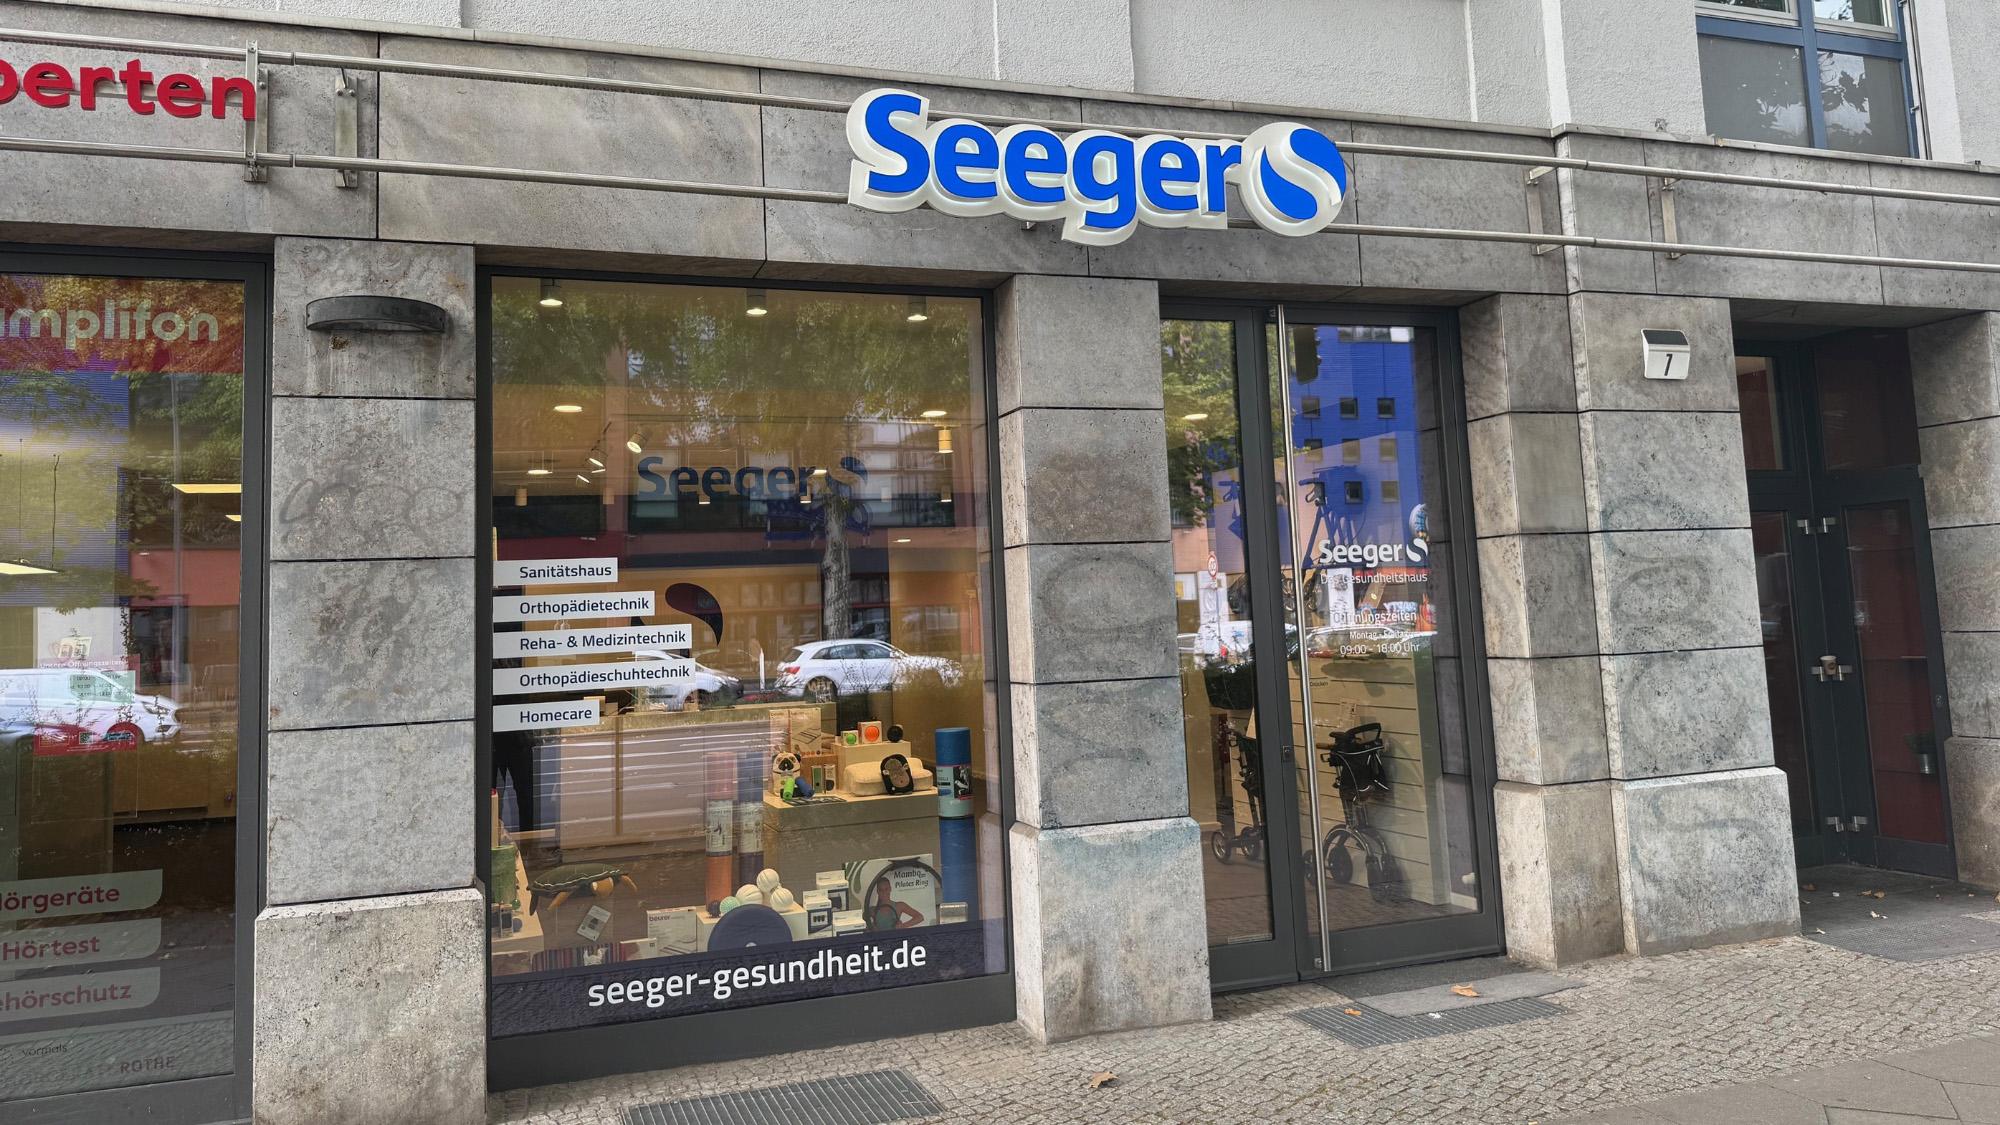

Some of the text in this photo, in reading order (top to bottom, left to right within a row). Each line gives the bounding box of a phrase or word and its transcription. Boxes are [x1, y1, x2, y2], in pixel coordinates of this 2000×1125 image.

[865, 93, 1242, 229] Seeger
[0, 298, 219, 350] mplifon
[1663, 353, 1673, 376] 7
[1318, 539, 1403, 568] Seeger
[519, 564, 612, 579] Sanitätshaus
[1343, 571, 1428, 584] Gesundheitshaus
[519, 597, 649, 616] Orthopädietechnik
[519, 630, 686, 650] Reha- & Medizintechnik
[1349, 630, 1377, 640] Montag
[1340, 645, 1367, 655] 09:00
[1377, 643, 1402, 654] 18:00
[1404, 641, 1420, 652] Uhr
[519, 665, 690, 687] Orthopädieschuhtechnik
[519, 708, 592, 723] Homecare
[0, 885, 120, 913] örgeräte
[2, 935, 100, 961] Hörtest
[587, 940, 927, 1008] seeger-gesundheit.de
[0, 983, 132, 1011] hörschutz
